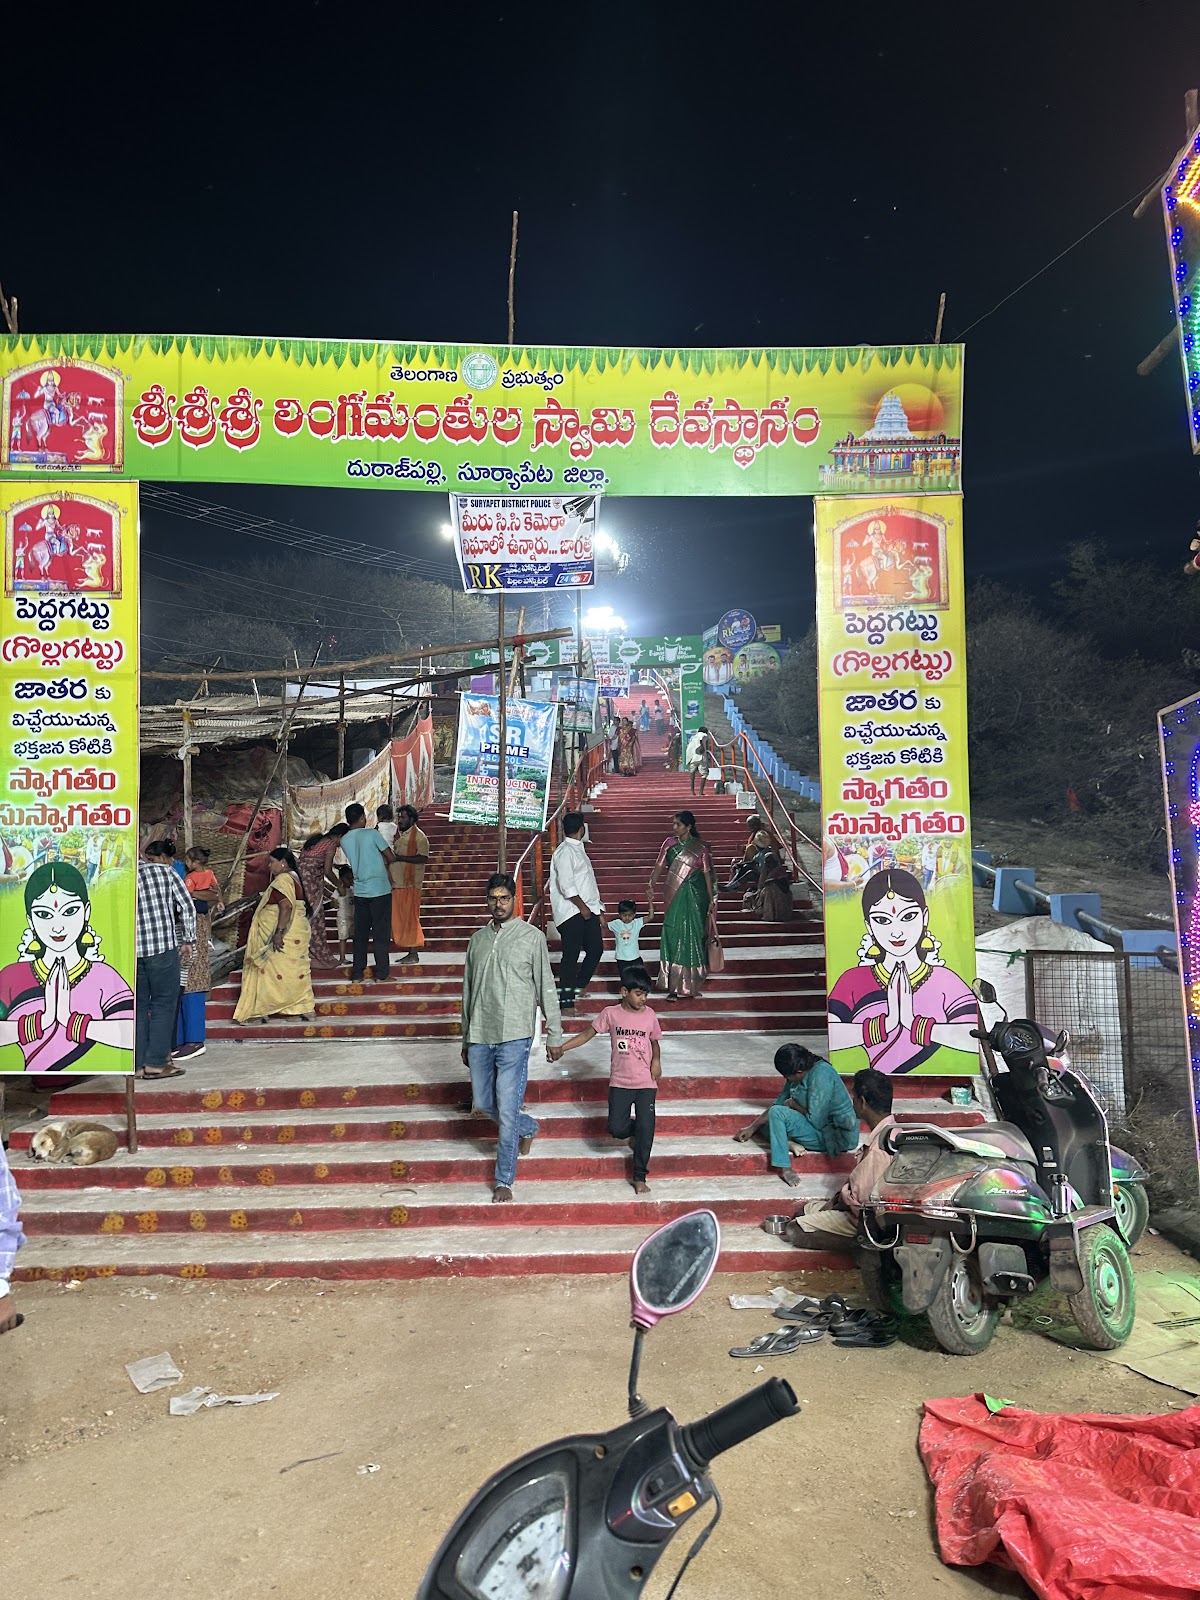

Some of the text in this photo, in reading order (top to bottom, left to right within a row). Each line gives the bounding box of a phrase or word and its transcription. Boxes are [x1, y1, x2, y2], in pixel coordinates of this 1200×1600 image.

[390, 366, 458, 383] తెలంగాణ
[501, 370, 564, 391] ప్రభుత్వం
[273, 389, 524, 447] లింగమంతుల
[530, 397, 637, 461] స్వామి
[648, 390, 822, 470] దేవస్థానం
[457, 461, 553, 491] సూర్యాపేట
[471, 499, 551, 508] SURYAPET DISTRICT POLICE
[462, 510, 493, 531] మీరు
[523, 512, 565, 531] కెమెరా
[467, 564, 503, 588] RK
[16, 597, 110, 631] పెద్దగట్టు
[845, 610, 938, 645] పెద్దగట్టు
[2, 635, 124, 670] (గొల్లగట్టు)
[833, 650, 953, 681] (గొల్లగట్టు)
[14, 678, 111, 699] జాతర కు
[845, 690, 941, 712] జాతర కు
[12, 709, 117, 733] విచ్చేయుచున్న
[844, 721, 948, 744] విచ్చేయుచున్న
[489, 723, 522, 745] SR
[14, 737, 113, 760] భక్తజన కోటికి
[480, 742, 529, 758] PRME
[846, 747, 944, 771] భక్తజన కోటికి
[9, 767, 116, 797] స్వాగతం
[467, 775, 536, 790] INTROUCING
[842, 777, 948, 807] స్వాగతం
[0, 803, 131, 833] సుస్వాగతం
[828, 811, 965, 841] సుస్వాగతం
